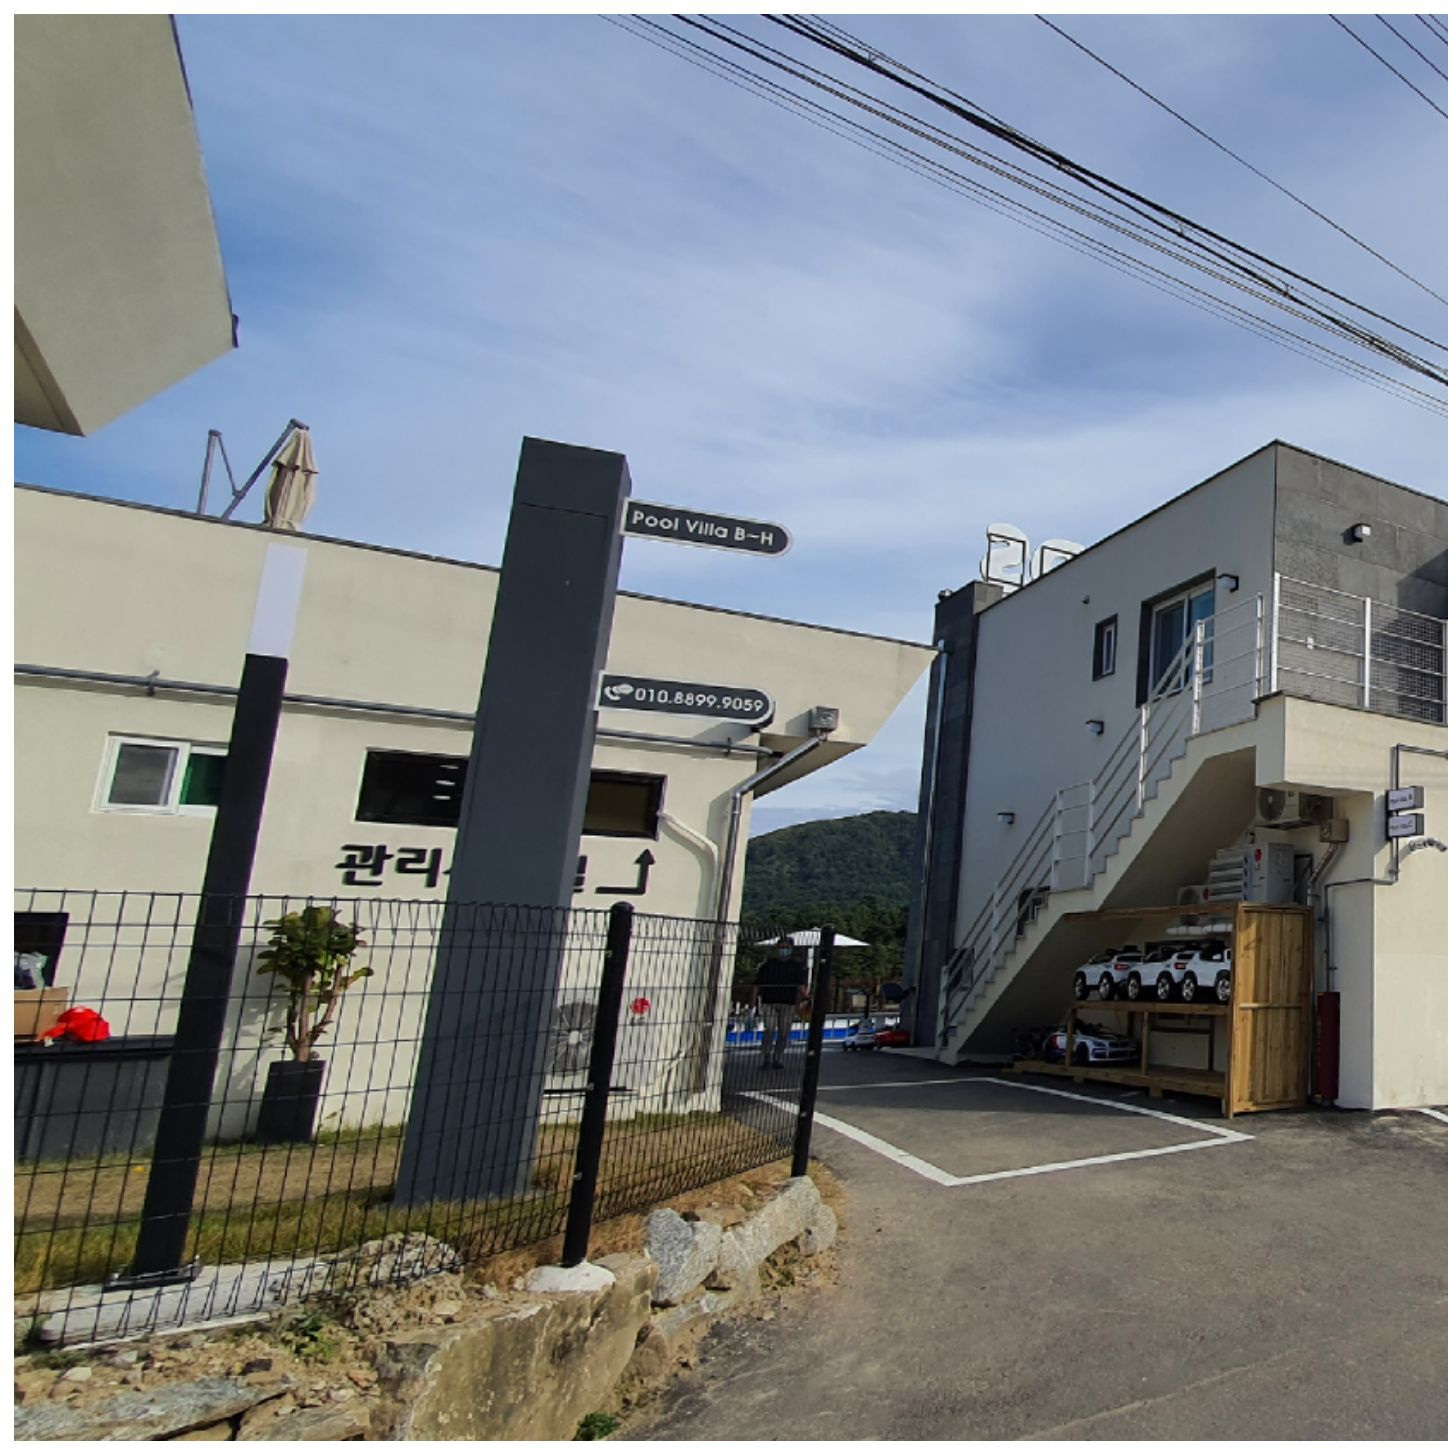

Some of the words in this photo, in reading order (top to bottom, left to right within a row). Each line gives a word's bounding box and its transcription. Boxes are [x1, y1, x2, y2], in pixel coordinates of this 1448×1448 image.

[632, 511, 678, 531] Pool
[685, 519, 728, 539] Villa
[634, 687, 763, 712] 010.8899.9059
